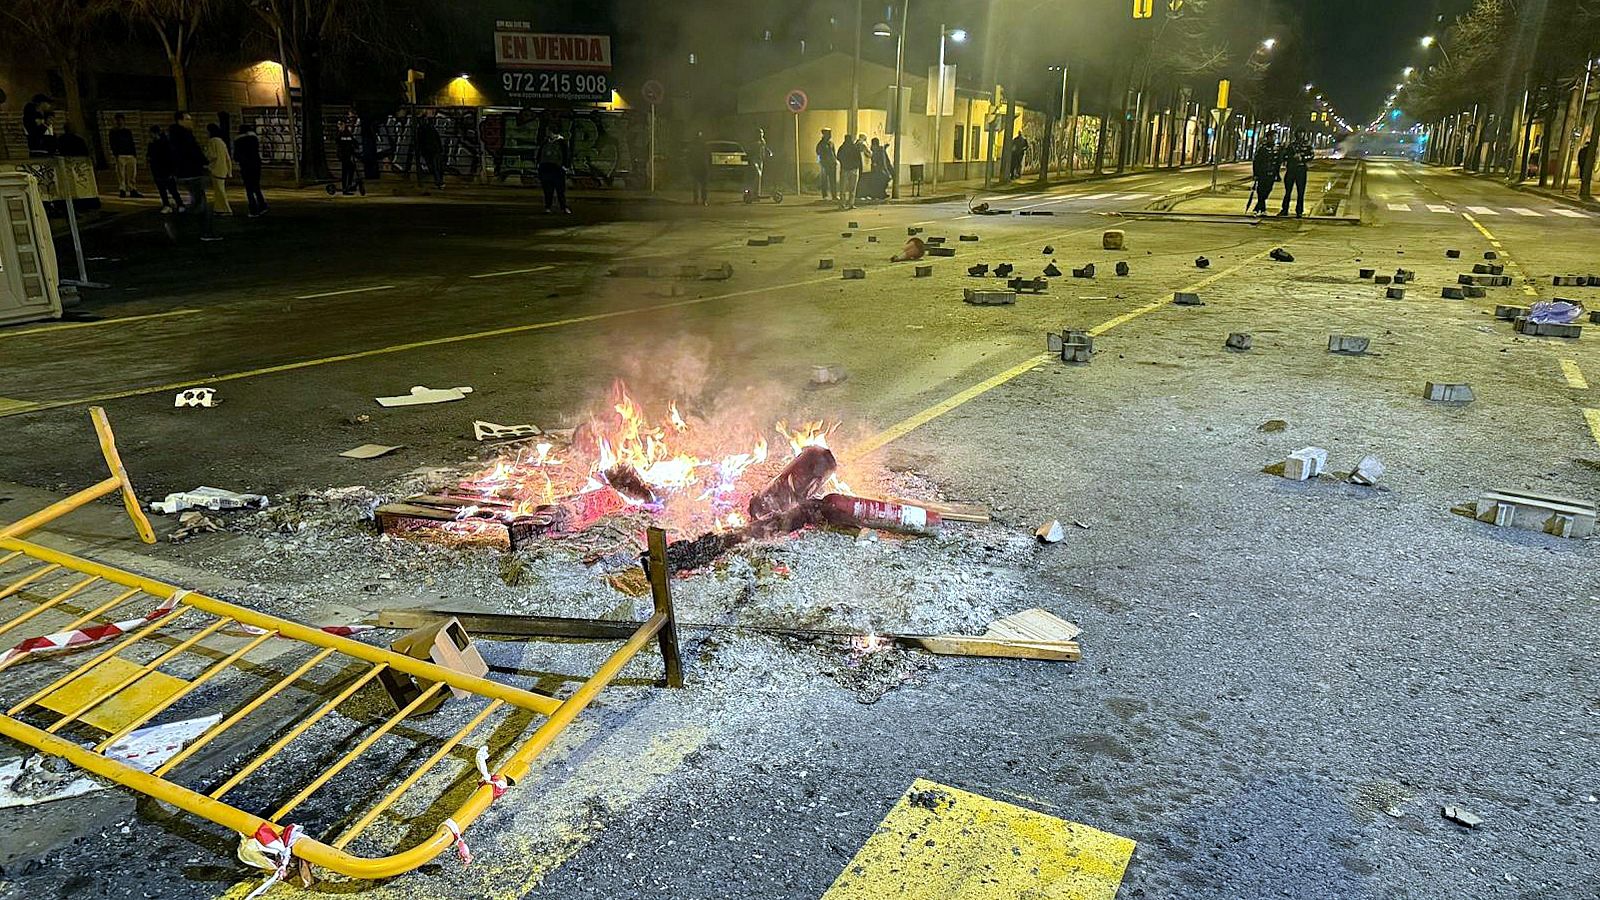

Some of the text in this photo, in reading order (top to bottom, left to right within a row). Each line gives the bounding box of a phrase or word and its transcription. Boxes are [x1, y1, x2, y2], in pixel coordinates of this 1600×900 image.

[501, 36, 604, 62] EN VENDA
[502, 73, 607, 94] 972 215 908
